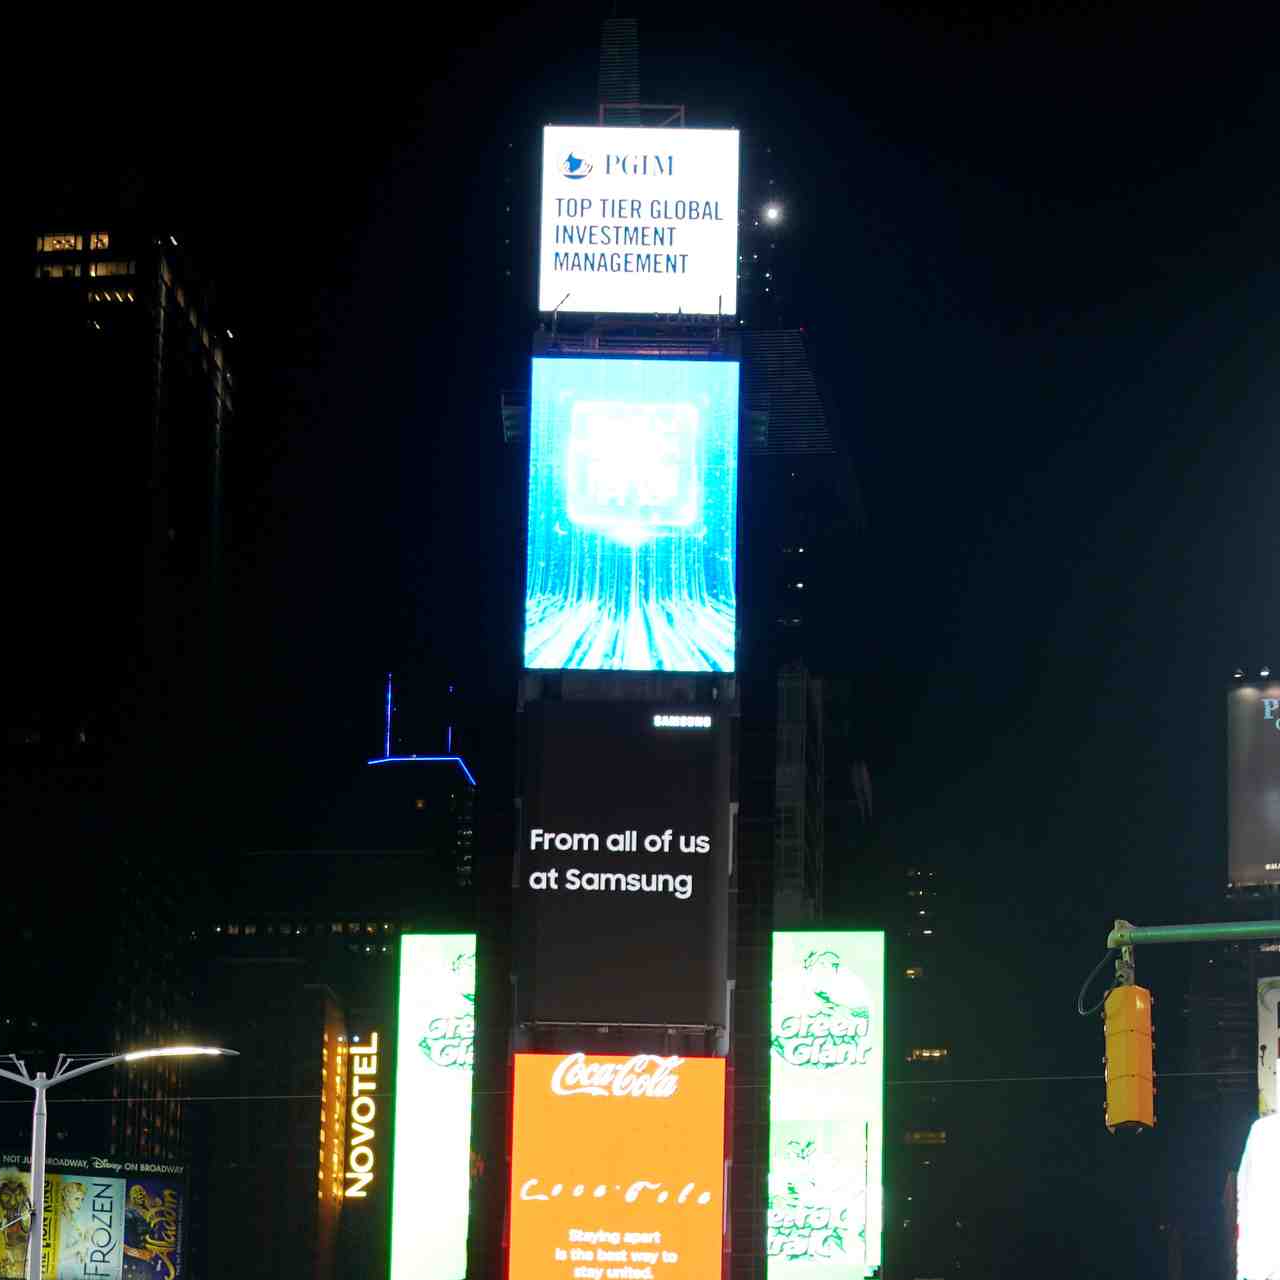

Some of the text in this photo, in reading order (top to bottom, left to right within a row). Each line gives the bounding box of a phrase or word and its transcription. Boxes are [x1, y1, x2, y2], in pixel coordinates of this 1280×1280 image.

[605, 154, 674, 176] PGIM
[555, 198, 724, 221] TOP TIER GLOBAL
[555, 224, 677, 246] INVESTMENT
[553, 251, 689, 274] MANAGEMENT
[653, 715, 712, 728] SAMSUNG
[530, 829, 711, 854] From all of us
[529, 868, 693, 900] at Samsung
[551, 1052, 685, 1098] Coca-Cola
[344, 1031, 378, 1198] NOVOTEL
[91, 1156, 124, 1172] Disney
[124, 1163, 138, 1171] ON
[139, 1163, 185, 1174] BROADWAY
[83, 1183, 113, 1277] FROZEN
[568, 1228, 662, 1245] Staying apart
[555, 1248, 679, 1264] is the best way to
[607, 1265, 654, 1280] united.
